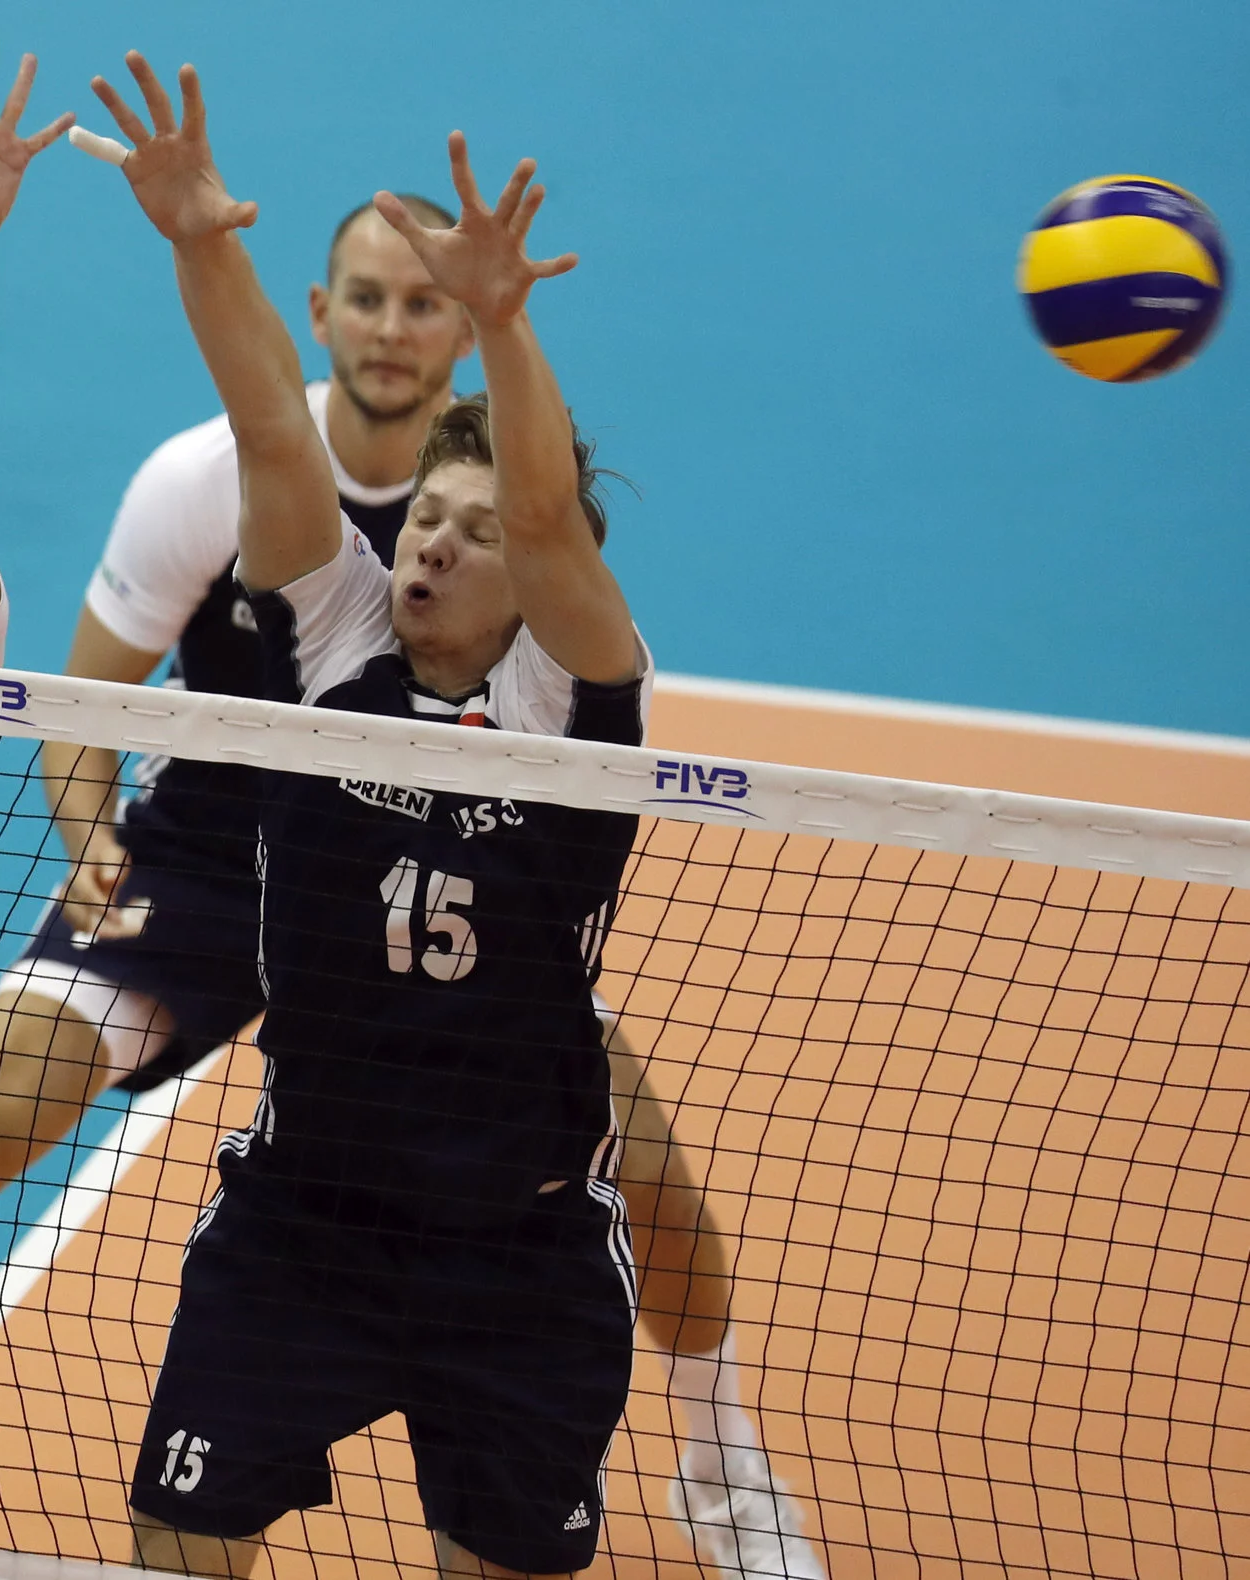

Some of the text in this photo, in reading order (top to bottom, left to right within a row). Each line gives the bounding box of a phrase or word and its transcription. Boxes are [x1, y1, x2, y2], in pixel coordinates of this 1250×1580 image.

[655, 760, 748, 799] FIVB
[379, 856, 478, 981] 15
[159, 1429, 212, 1495] 15
[563, 1517, 591, 1531] adidas
